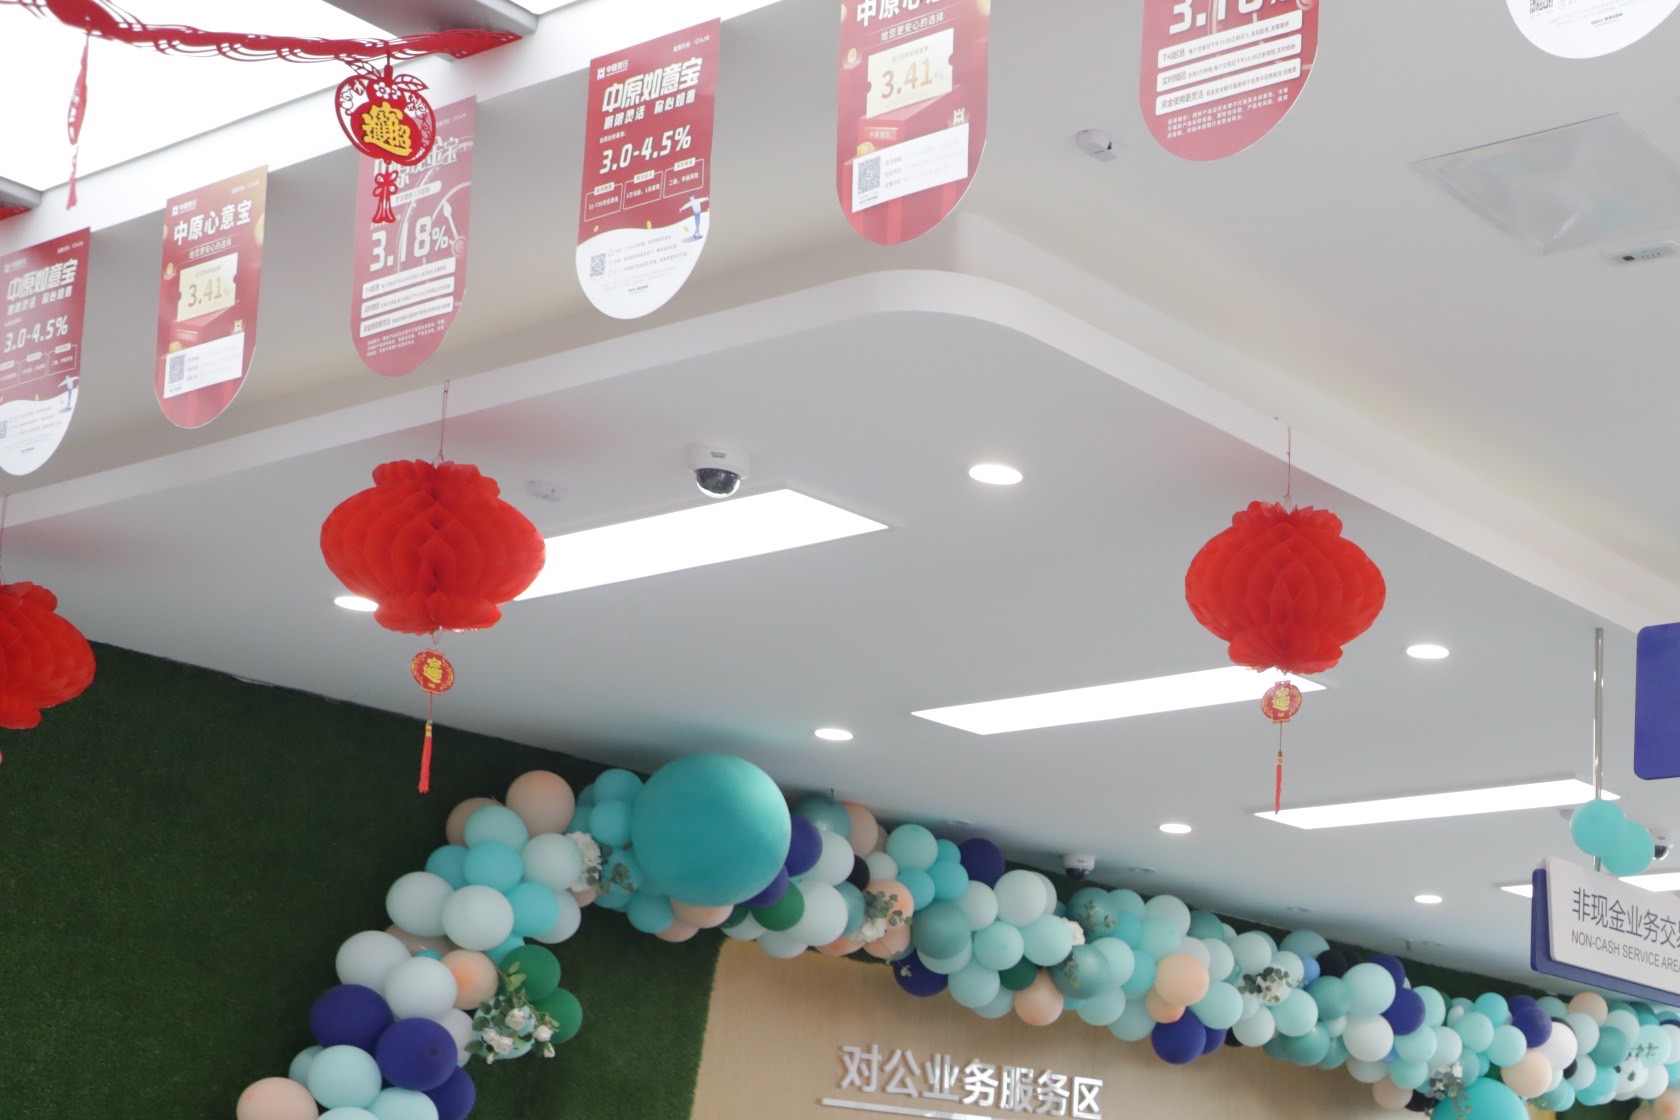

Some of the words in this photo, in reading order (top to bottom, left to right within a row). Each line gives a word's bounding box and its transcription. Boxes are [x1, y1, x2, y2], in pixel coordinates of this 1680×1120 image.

[881, 11, 944, 41] 给您更安心的选择
[602, 57, 702, 113] 中原如意宝
[600, 125, 692, 174] 3.0-4.5%
[174, 199, 252, 245] 中原心意宝
[370, 215, 448, 272] 3.18%
[7, 259, 78, 301] 中原如意宝
[4, 315, 68, 353] 3.0-4.5%
[1571, 930, 1620, 956] NON-CASH
[1622, 944, 1659, 968] SERVICE
[839, 1043, 1104, 1120] 对公业务服务区
